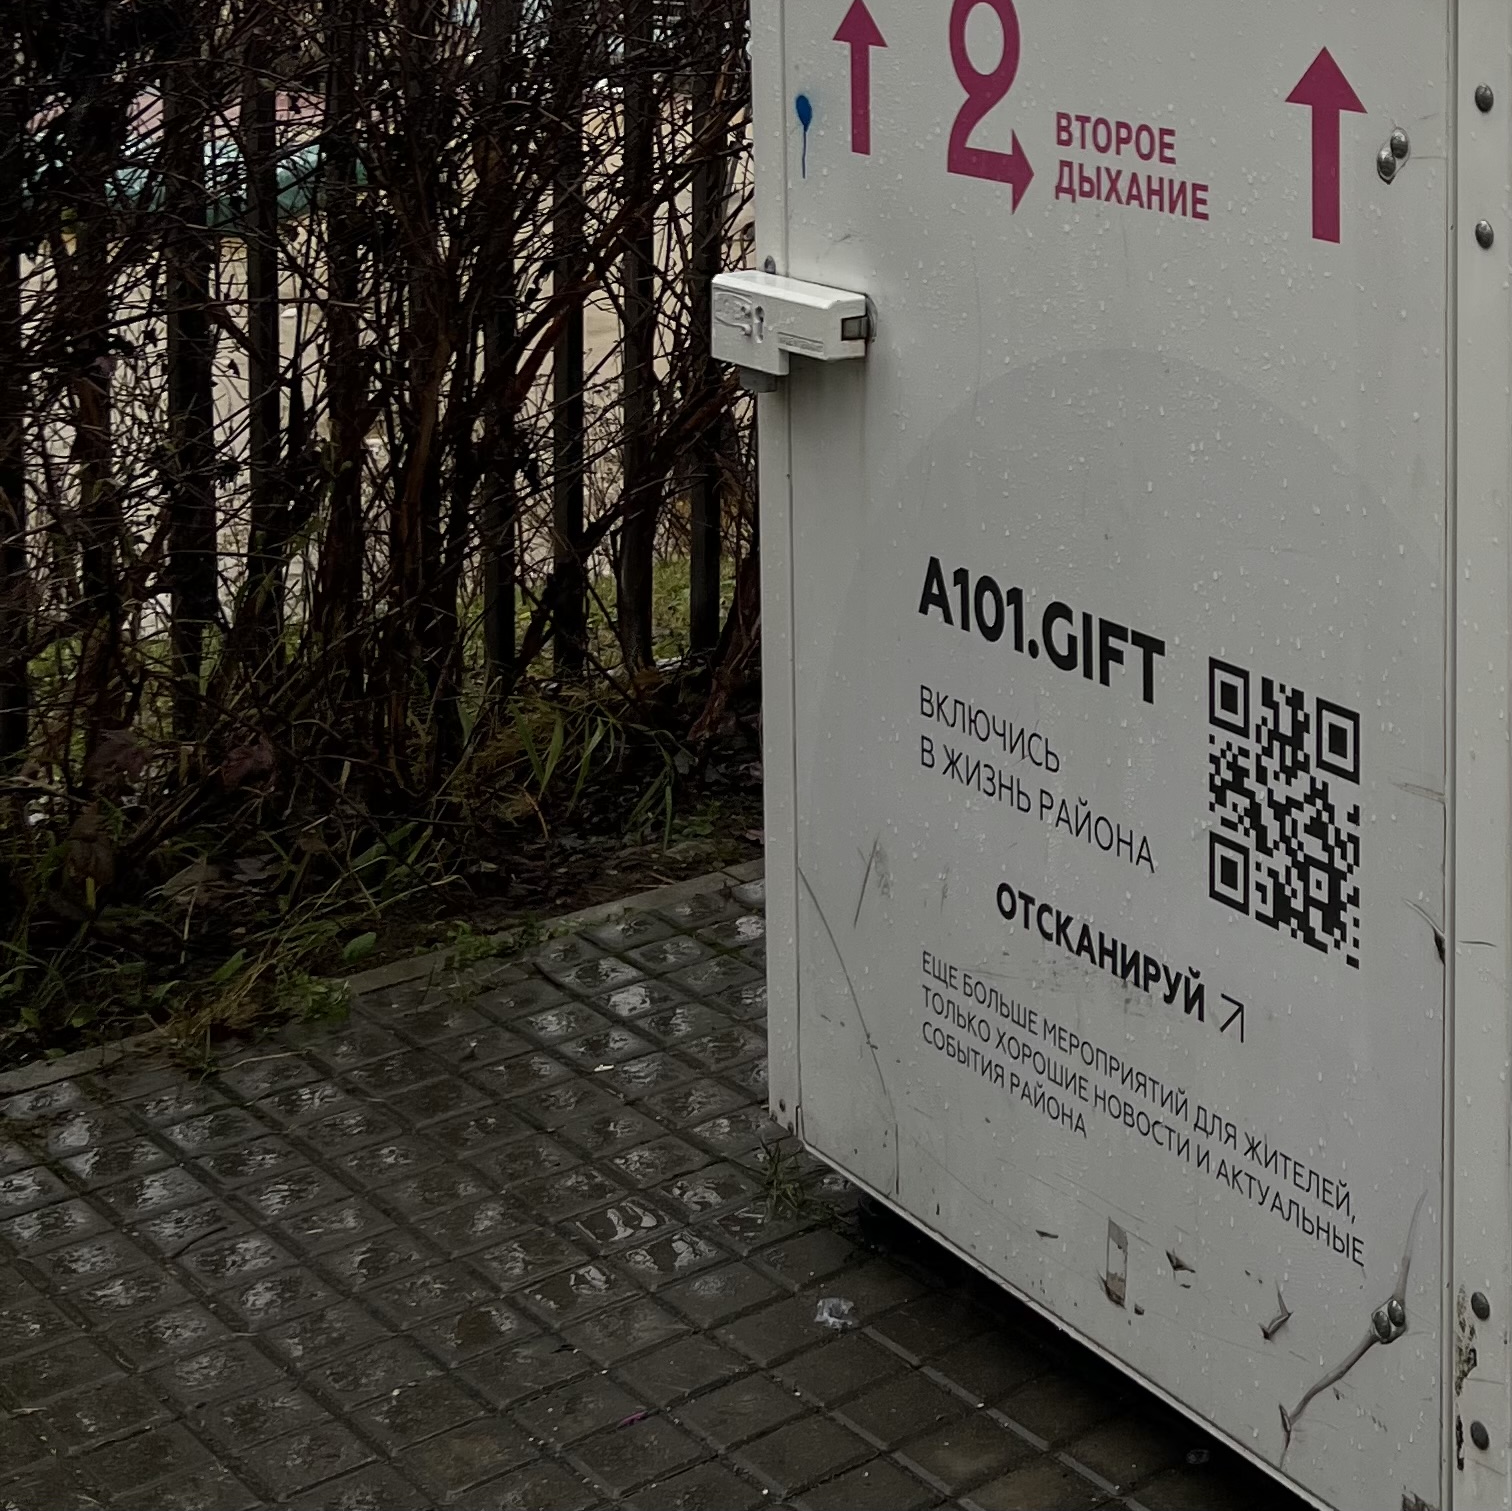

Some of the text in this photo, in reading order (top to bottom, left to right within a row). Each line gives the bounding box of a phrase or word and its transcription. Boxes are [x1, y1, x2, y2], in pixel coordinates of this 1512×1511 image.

[1055, 160, 1209, 221] ДЫХАНИЕ
[1056, 112, 1176, 165] ВТОРОЕ
[918, 556, 1165, 705] A101.GIFT
[921, 685, 1059, 773] ВКЛЮЧИСЬ
[921, 735, 1155, 873] В ЖИЗНЬ РАЙОНА
[997, 883, 1205, 1022] ОТСКАНИРУЙ
[922, 985, 1366, 1267] ТОЛЬКО ХОРОШИЕ НОВОСТИ И АКТУАЛЬНЫЕ
[923, 1022, 1087, 1138] СОБЫТИЯ РАЙОНА
[923, 951, 1355, 1224] ЕЩЕ БОЛЬШЕ МЕРОПРИЯТИЙ ДЛЯ ЖИТЕЛЕЙ,
